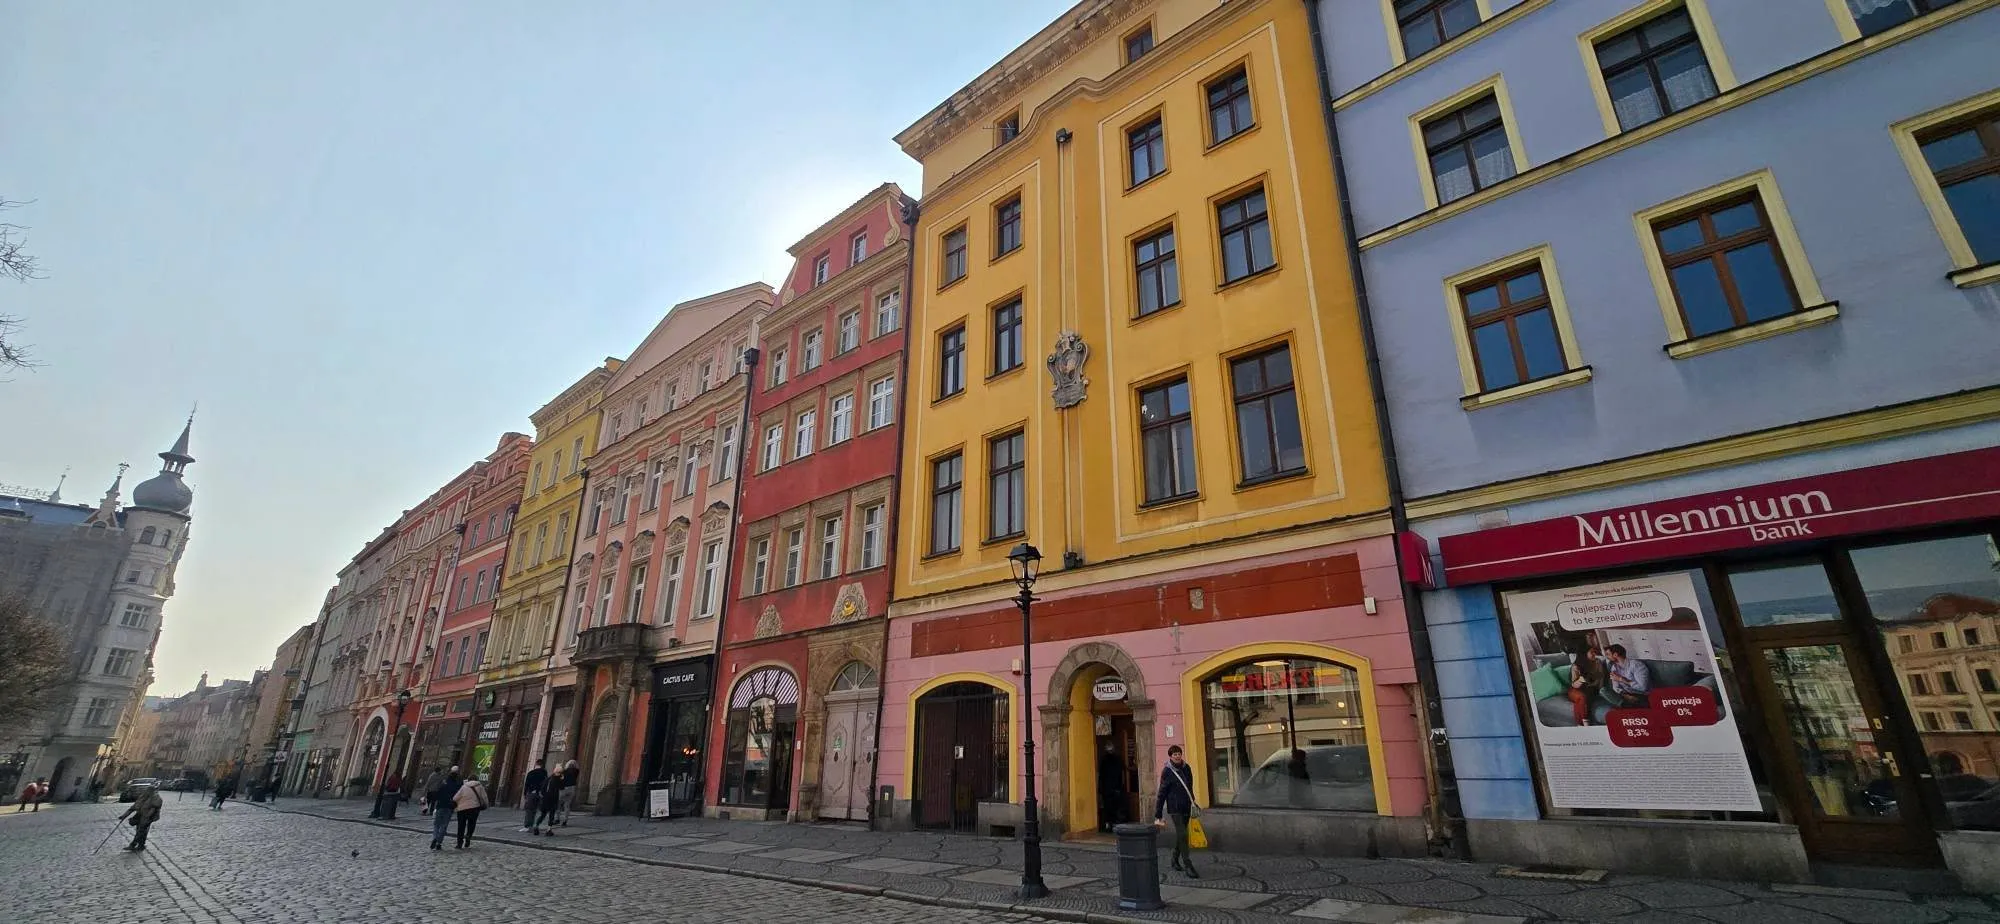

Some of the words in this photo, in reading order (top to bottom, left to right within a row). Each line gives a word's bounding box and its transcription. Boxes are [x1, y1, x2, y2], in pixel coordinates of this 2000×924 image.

[1573, 489, 1832, 547] Millennium
[1748, 519, 1813, 542] bank
[1570, 603, 1616, 615] Najlepsze
[1617, 600, 1643, 609] plany
[1573, 617, 1583, 625] to
[1584, 616, 1594, 624] te
[1596, 610, 1659, 623] zrealizowane
[663, 675, 681, 684] CACTUS
[681, 673, 695, 682] CAFE
[1661, 696, 1702, 707] prowizja
[1677, 708, 1693, 716] 0%
[1621, 717, 1649, 726] RRSO
[1626, 728, 1650, 737] 8,3%
